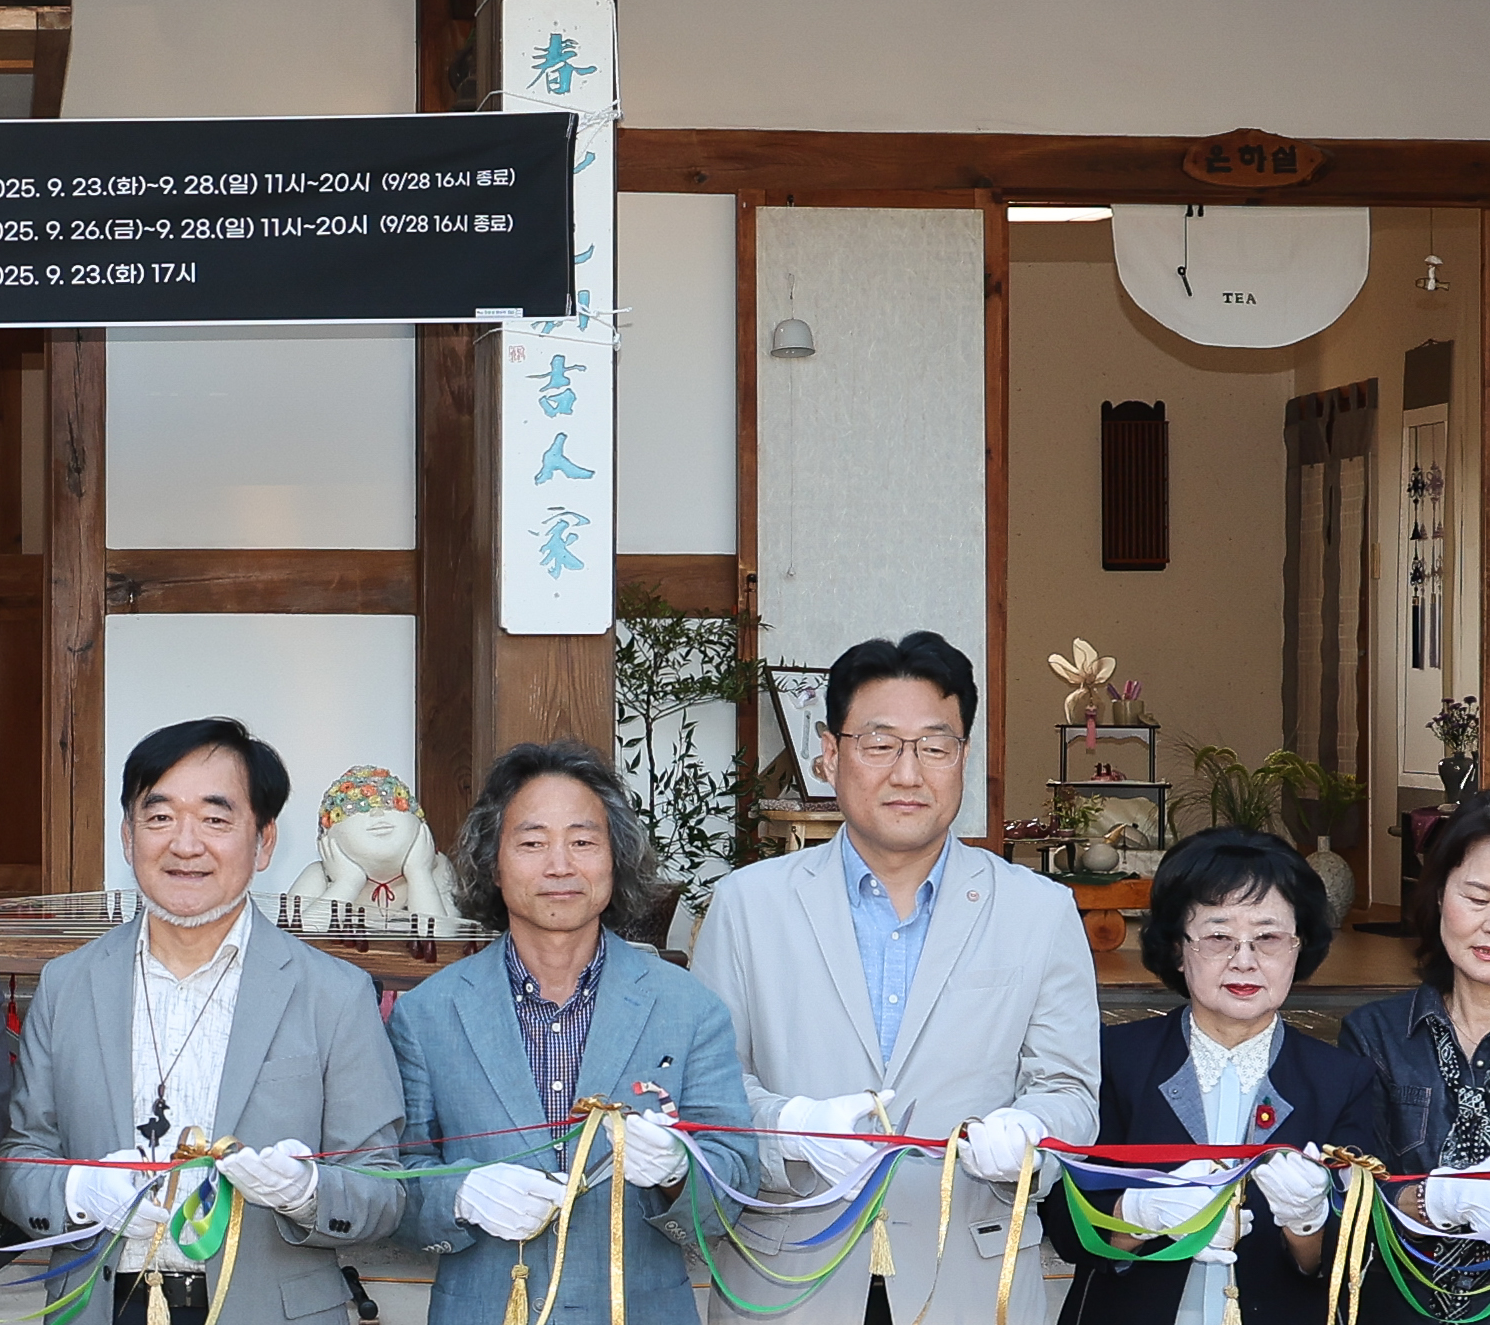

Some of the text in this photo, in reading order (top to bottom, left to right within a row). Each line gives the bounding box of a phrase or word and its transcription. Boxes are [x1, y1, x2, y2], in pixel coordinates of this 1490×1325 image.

[1206, 144, 1298, 174] 은하실
[46, 177, 66, 198] 9.
[183, 172, 259, 196] 28.(일)
[381, 171, 431, 192] (9/28
[434, 170, 471, 189] 16시
[475, 167, 516, 187] 종료)
[45, 220, 64, 241] 9.
[180, 216, 255, 240] 28.(일)
[379, 213, 429, 234] (9/28
[433, 214, 469, 233] 16시
[473, 213, 514, 233] 종료)
[45, 264, 65, 286] 9.
[70, 262, 145, 285] 23.(화)
[150, 261, 196, 284] 17시
[525, 33, 599, 580] 春吉人家
[1222, 292, 1257, 305] TEA
